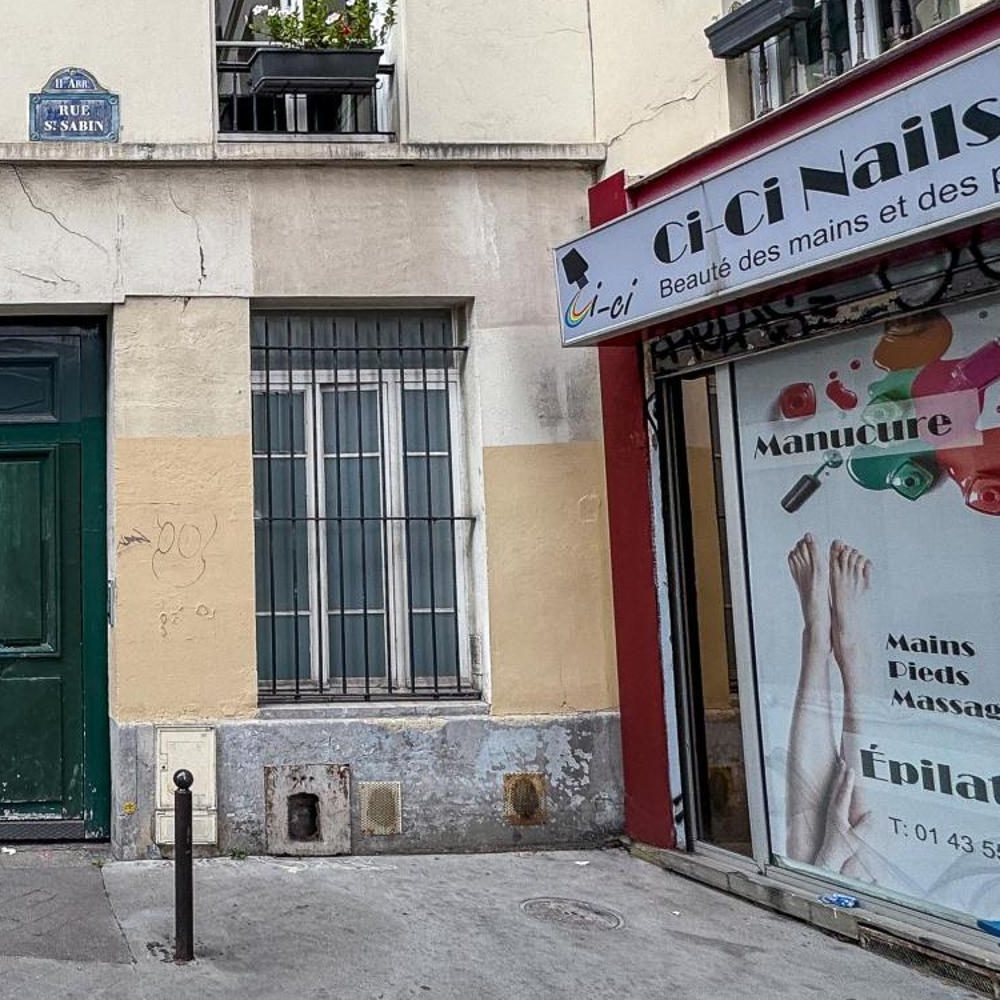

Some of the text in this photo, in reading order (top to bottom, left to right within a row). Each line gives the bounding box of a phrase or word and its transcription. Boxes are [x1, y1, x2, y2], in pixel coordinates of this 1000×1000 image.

[59, 105, 90, 116] RUE
[60, 120, 104, 131] SABIN
[800, 97, 1000, 211] Nails
[659, 256, 732, 299] Beauté
[738, 245, 781, 272] des
[788, 213, 870, 256] mains
[879, 196, 908, 224] et
[917, 176, 979, 211] des
[753, 413, 953, 460] Manucure
[886, 633, 976, 657] Mains
[887, 660, 970, 686] Pieds
[888, 816, 1000, 860] T: 01 43 5
